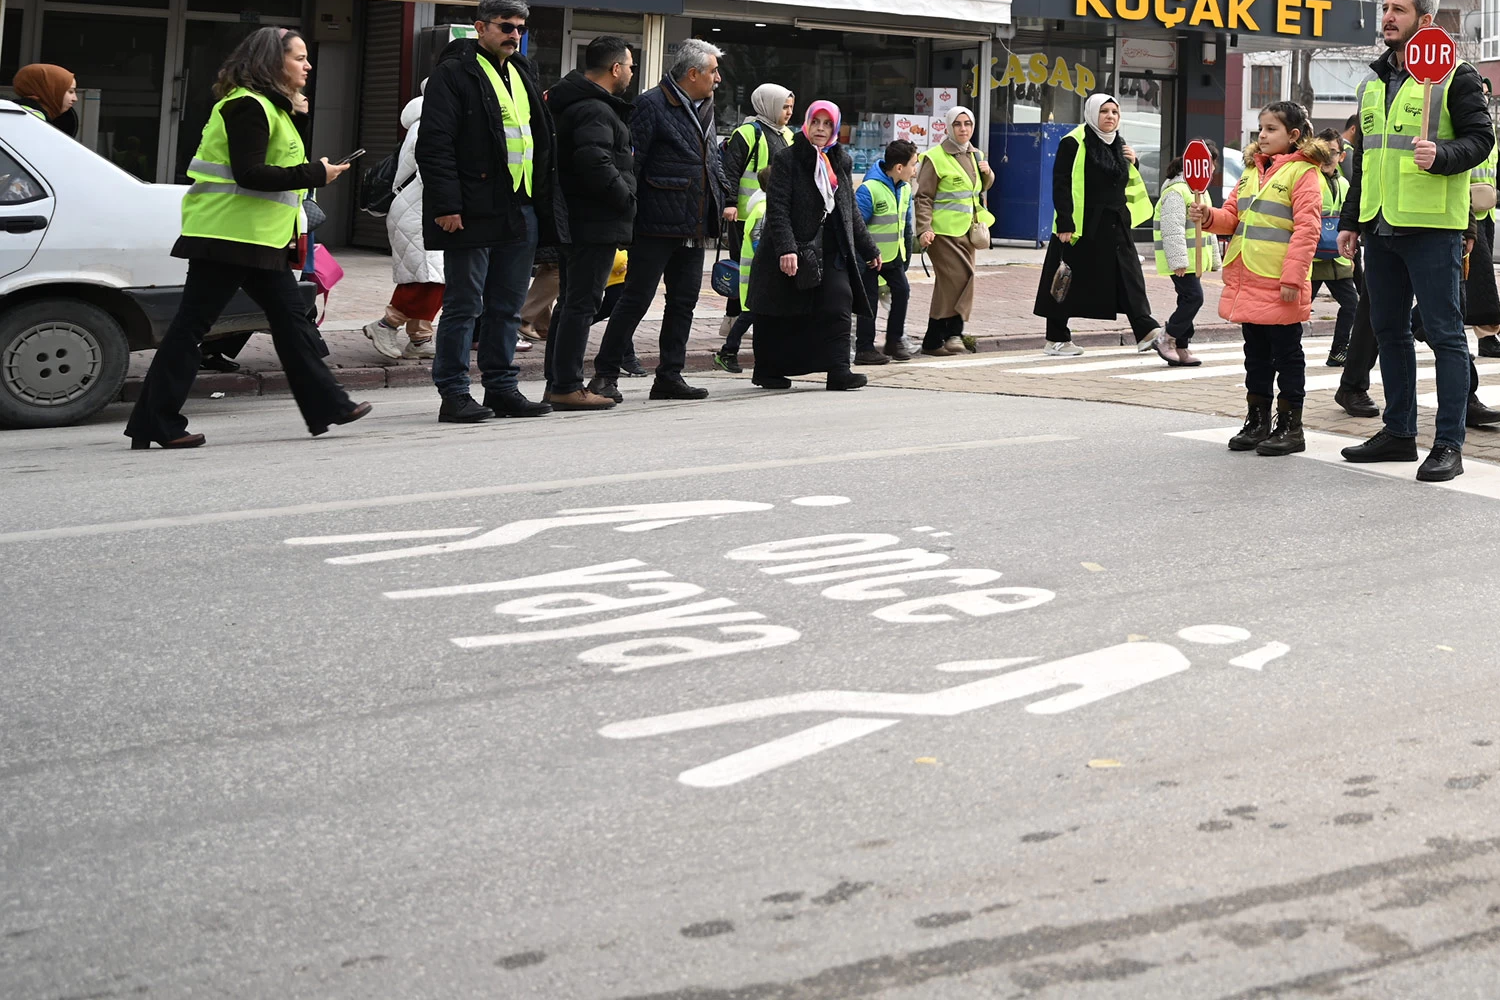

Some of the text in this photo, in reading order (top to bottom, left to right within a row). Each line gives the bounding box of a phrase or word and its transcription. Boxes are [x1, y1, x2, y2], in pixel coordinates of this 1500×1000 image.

[970, 53, 1096, 98] KASAP
[1409, 43, 1452, 65] DUR
[1185, 158, 1210, 179] DUR
[724, 524, 1056, 623] önce
[382, 558, 801, 673] yaya
